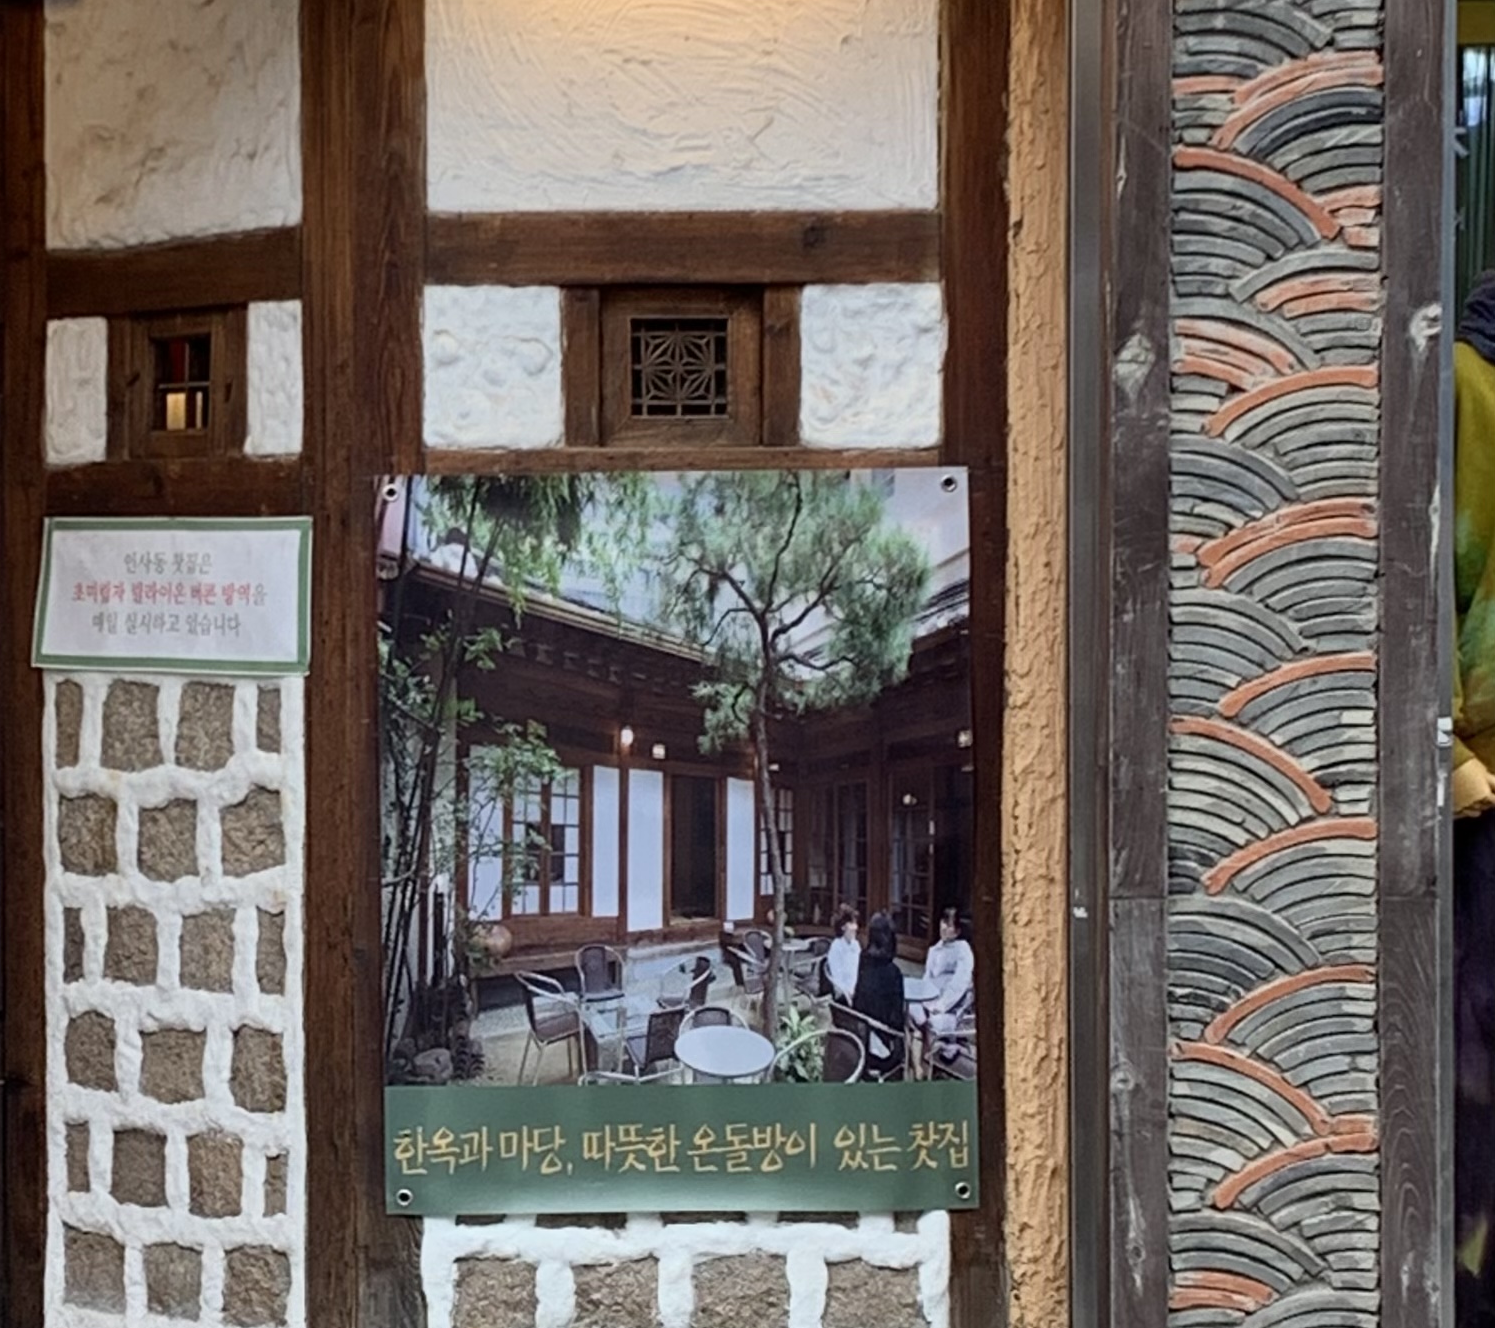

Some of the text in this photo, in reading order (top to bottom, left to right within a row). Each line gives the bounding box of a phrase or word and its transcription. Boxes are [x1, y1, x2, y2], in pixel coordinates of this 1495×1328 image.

[123, 551, 213, 575] 인사동 찻집은
[92, 611, 242, 638] 매일 실시하고 있습니다
[393, 1119, 970, 1176] 한옥과 마당, 따뜻한 온돌방이 있는 찻집
